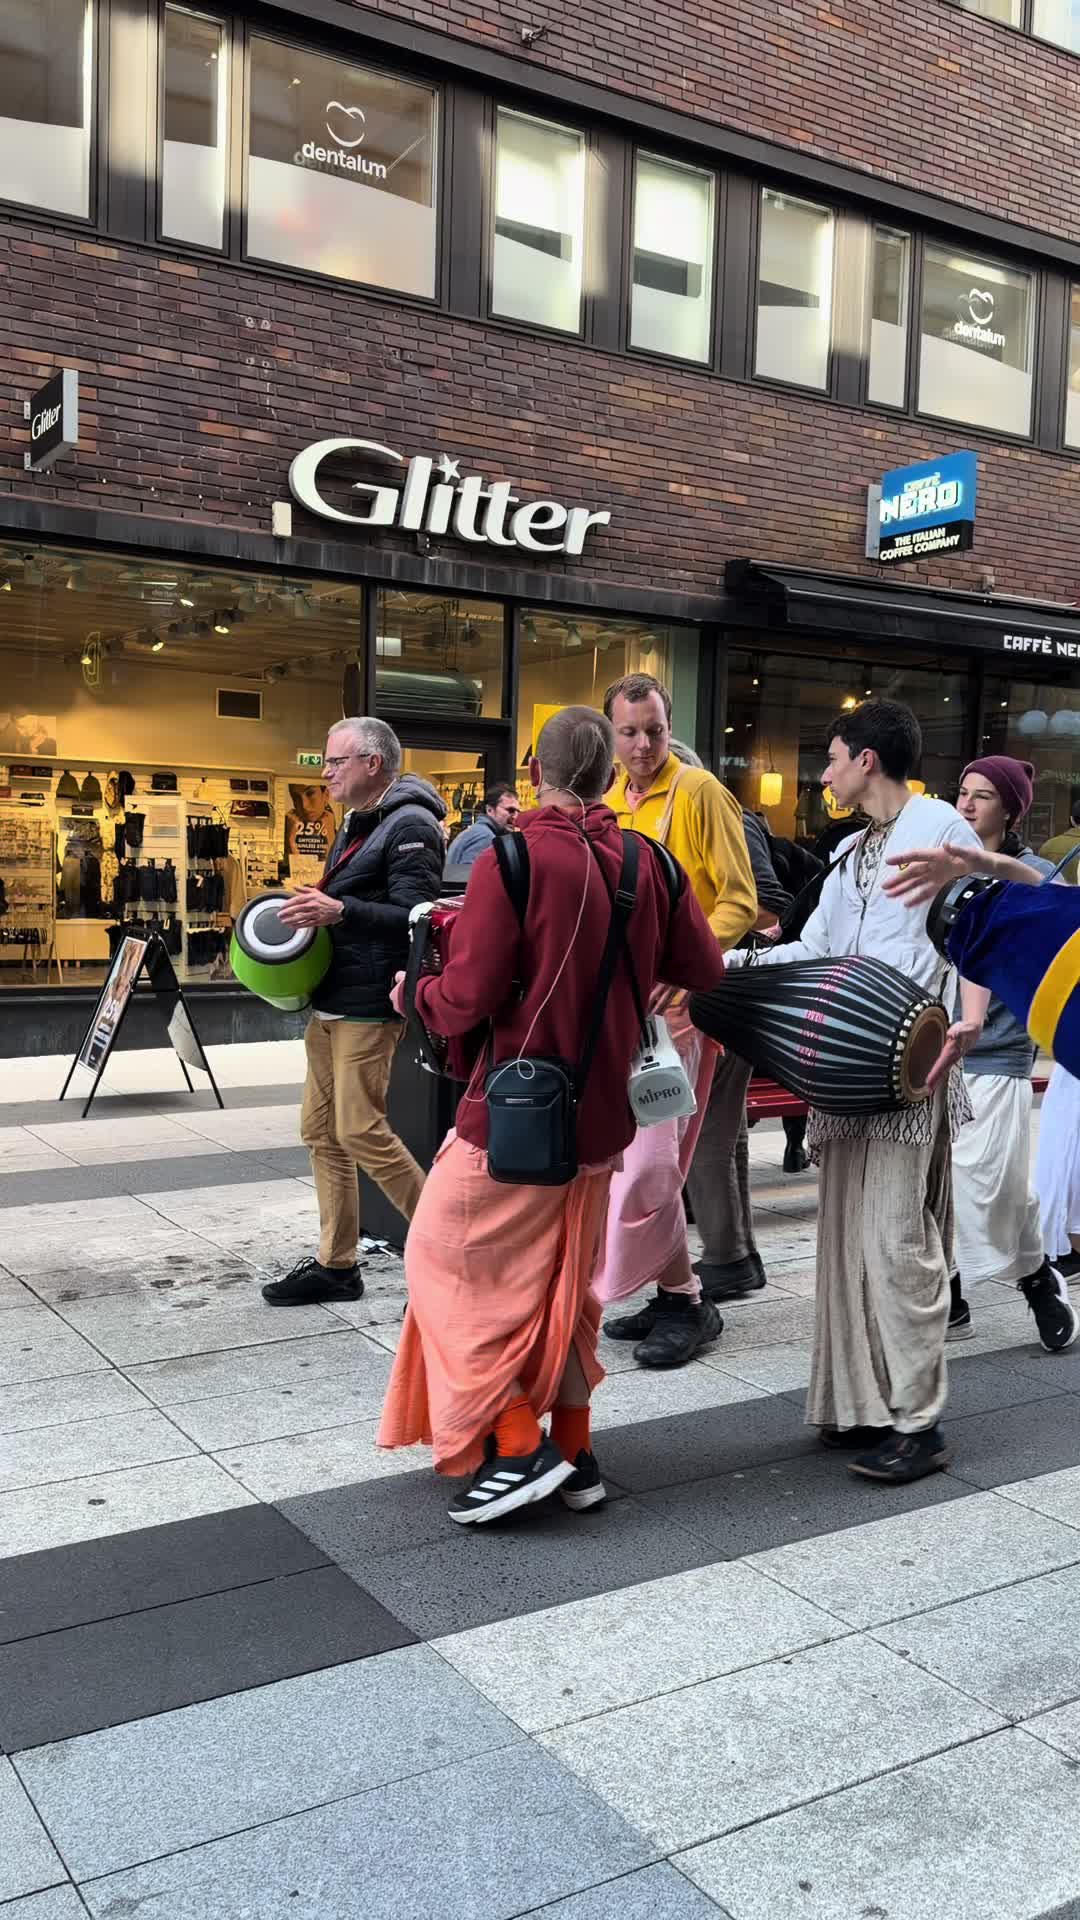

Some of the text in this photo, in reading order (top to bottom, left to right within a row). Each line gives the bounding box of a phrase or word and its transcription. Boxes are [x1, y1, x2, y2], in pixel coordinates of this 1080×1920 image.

[302, 141, 387, 178] dentalum
[953, 320, 1006, 347] dentalum
[31, 403, 62, 440] Glitter
[288, 437, 612, 555] Glitter
[880, 480, 961, 523] NERO
[880, 535, 960, 560] COFFEE COMPANY
[894, 527, 946, 547] THE ITALIAN
[1003, 635, 1080, 658] CAFFÈ NE
[295, 821, 329, 836] 25%
